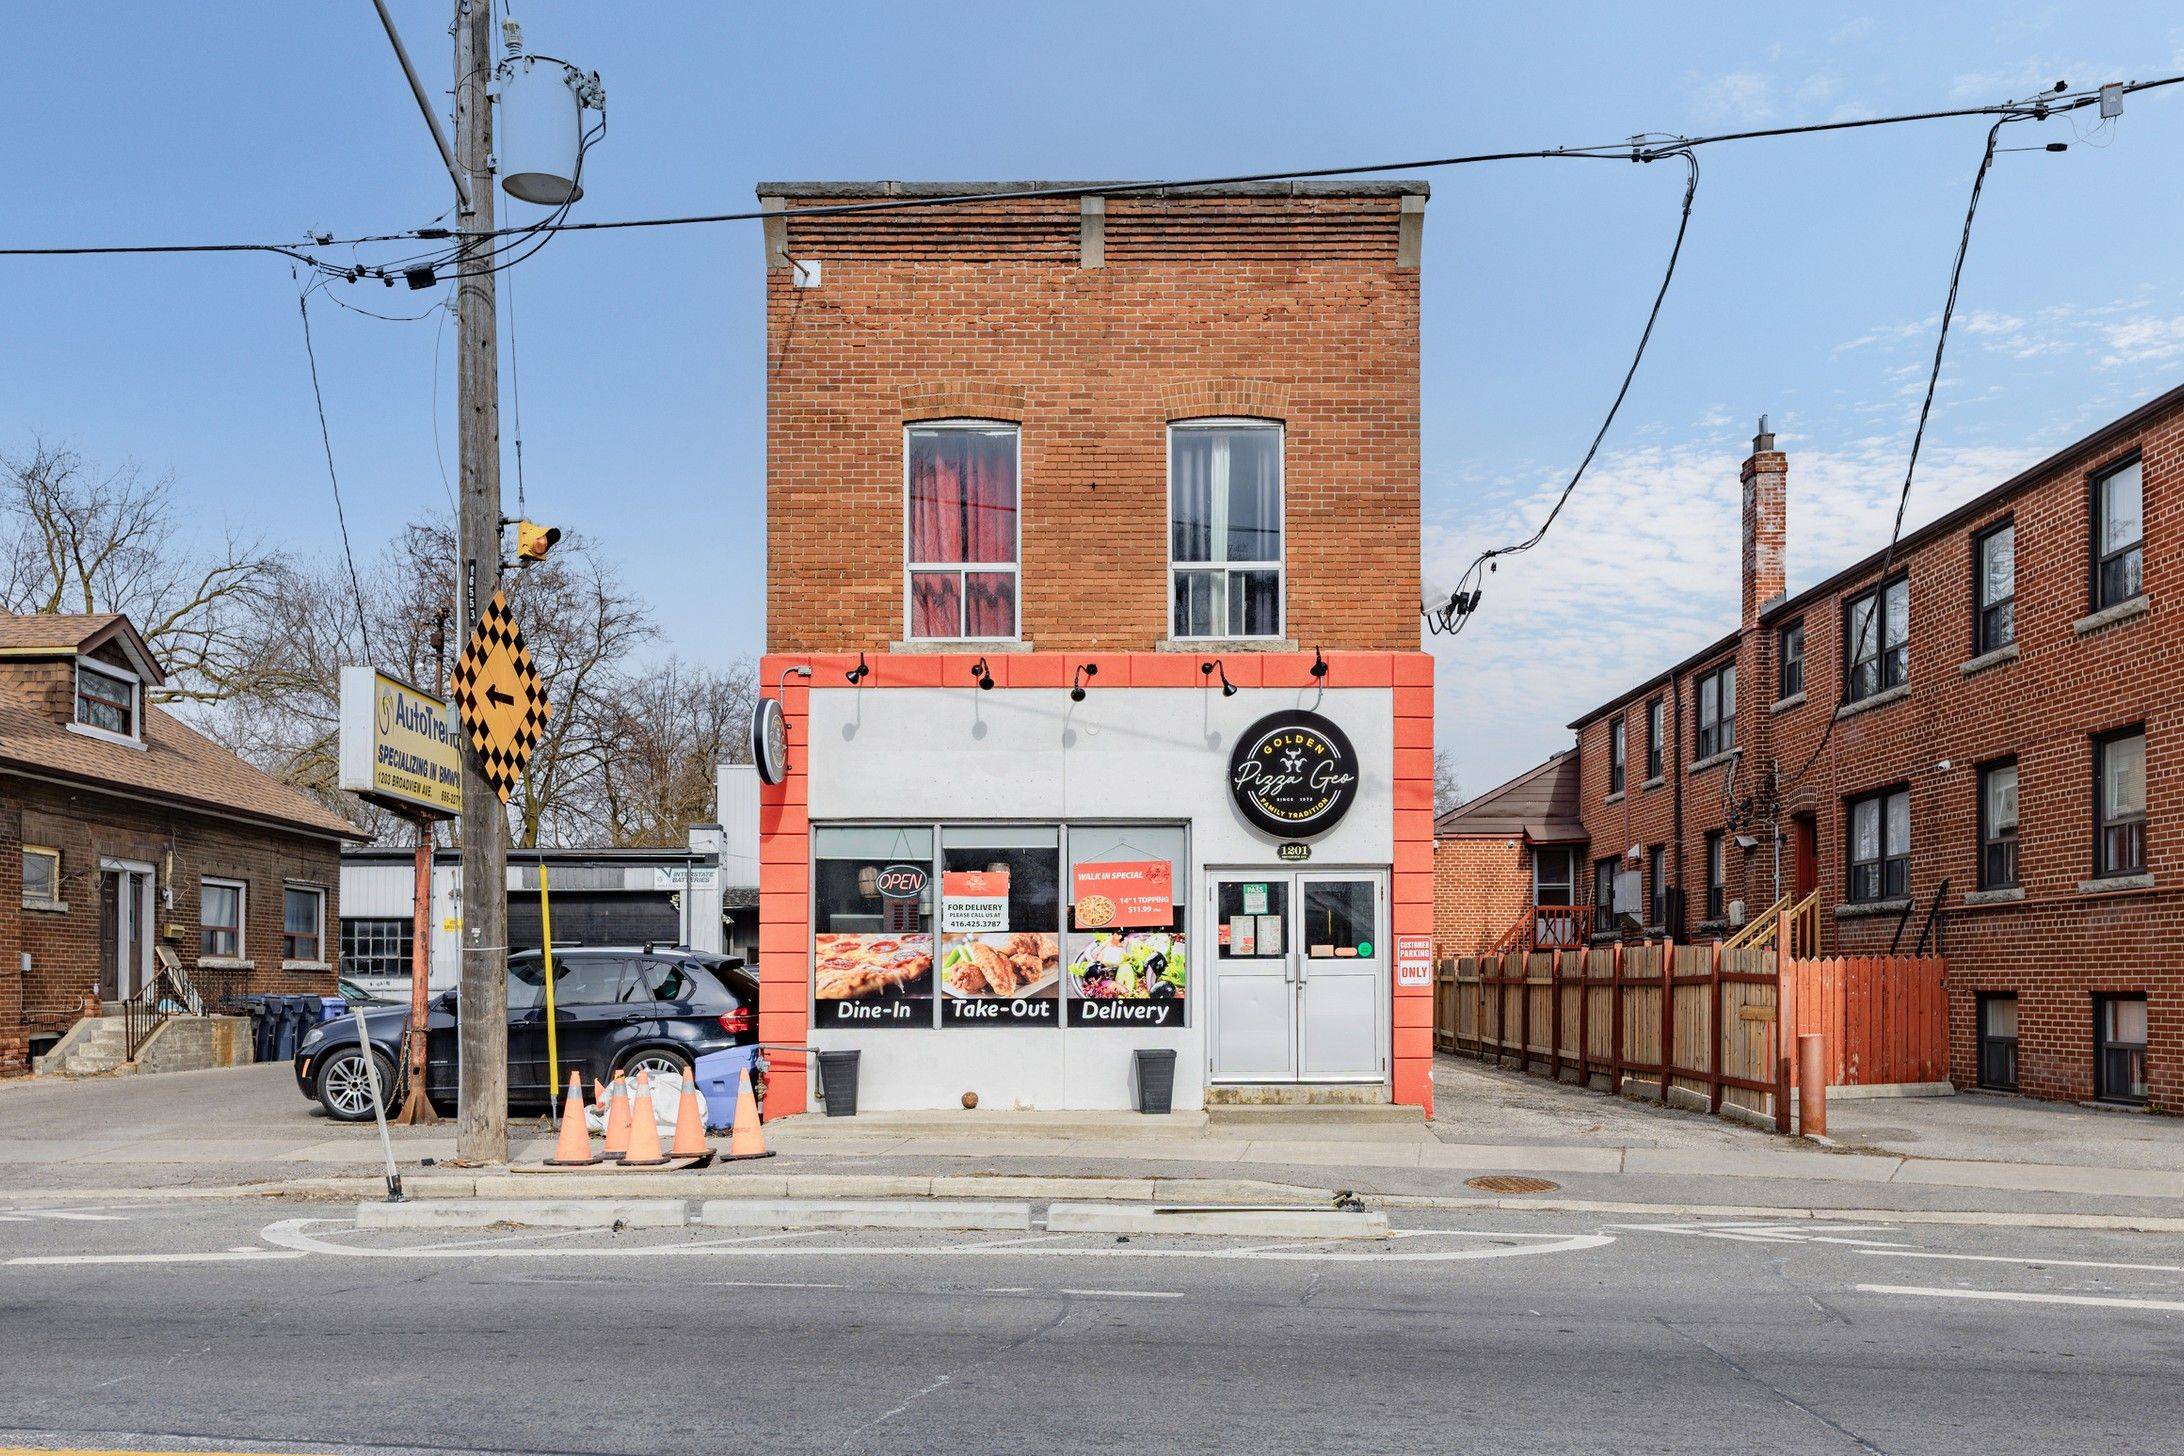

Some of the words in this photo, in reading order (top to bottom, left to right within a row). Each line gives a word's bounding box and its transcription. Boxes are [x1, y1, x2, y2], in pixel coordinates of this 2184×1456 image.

[1263, 735, 1325, 755] GOLDEN
[378, 744, 429, 778] SPECIALIZING
[430, 761, 437, 781] IN
[377, 771, 391, 785] 1203
[392, 775, 421, 795] BROADVIEW
[1234, 761, 1303, 796] Pizza
[1310, 760, 1354, 793] Geo
[1260, 798, 1285, 817] FAMILY
[1288, 797, 1329, 819] TRADITION
[1281, 846, 1308, 855] 1201
[879, 873, 923, 890] OPEN
[1078, 872, 1101, 881] WALK
[1102, 872, 1111, 880] IN
[1111, 871, 1144, 880] SPECIAL
[1138, 896, 1169, 904] TOPPING
[1400, 949, 1430, 958] PARKING
[1402, 967, 1427, 978] ONLY
[838, 1000, 911, 1019] Dine-In
[951, 999, 1050, 1018] Take-Out
[1081, 1000, 1170, 1025] Delivery
